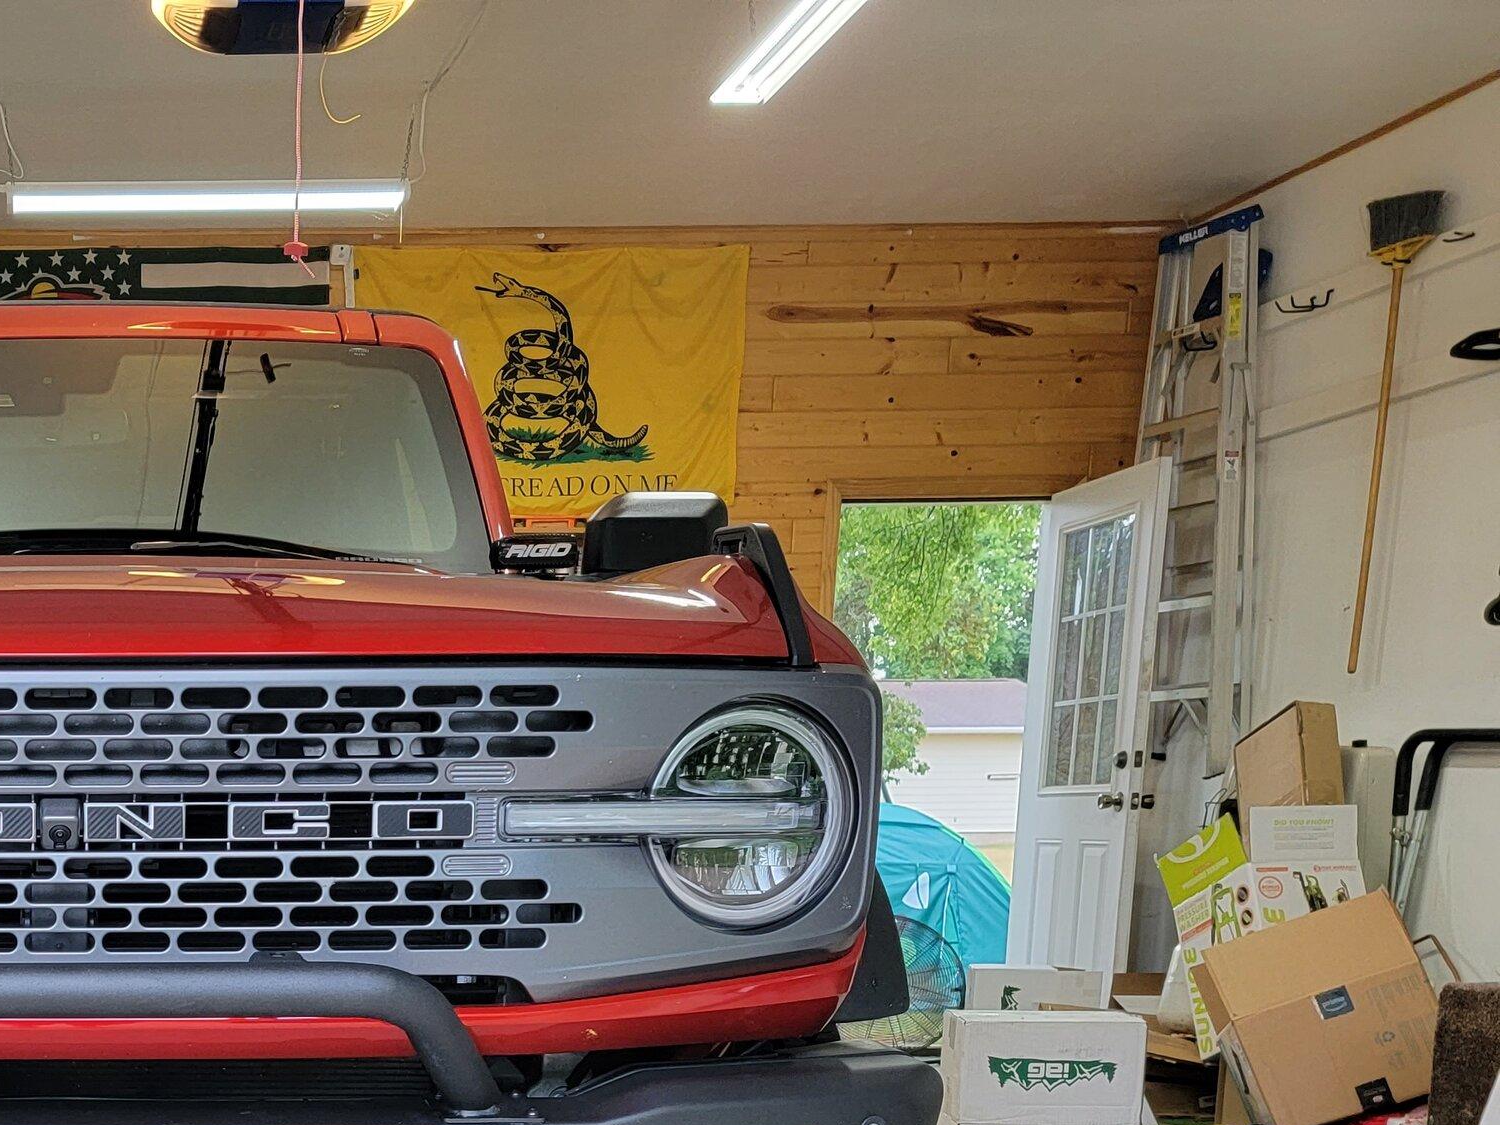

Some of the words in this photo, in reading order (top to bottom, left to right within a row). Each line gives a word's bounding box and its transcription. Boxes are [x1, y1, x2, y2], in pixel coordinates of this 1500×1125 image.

[591, 474, 632, 496] ON
[639, 474, 678, 492] ME
[505, 542, 571, 559] RIGID
